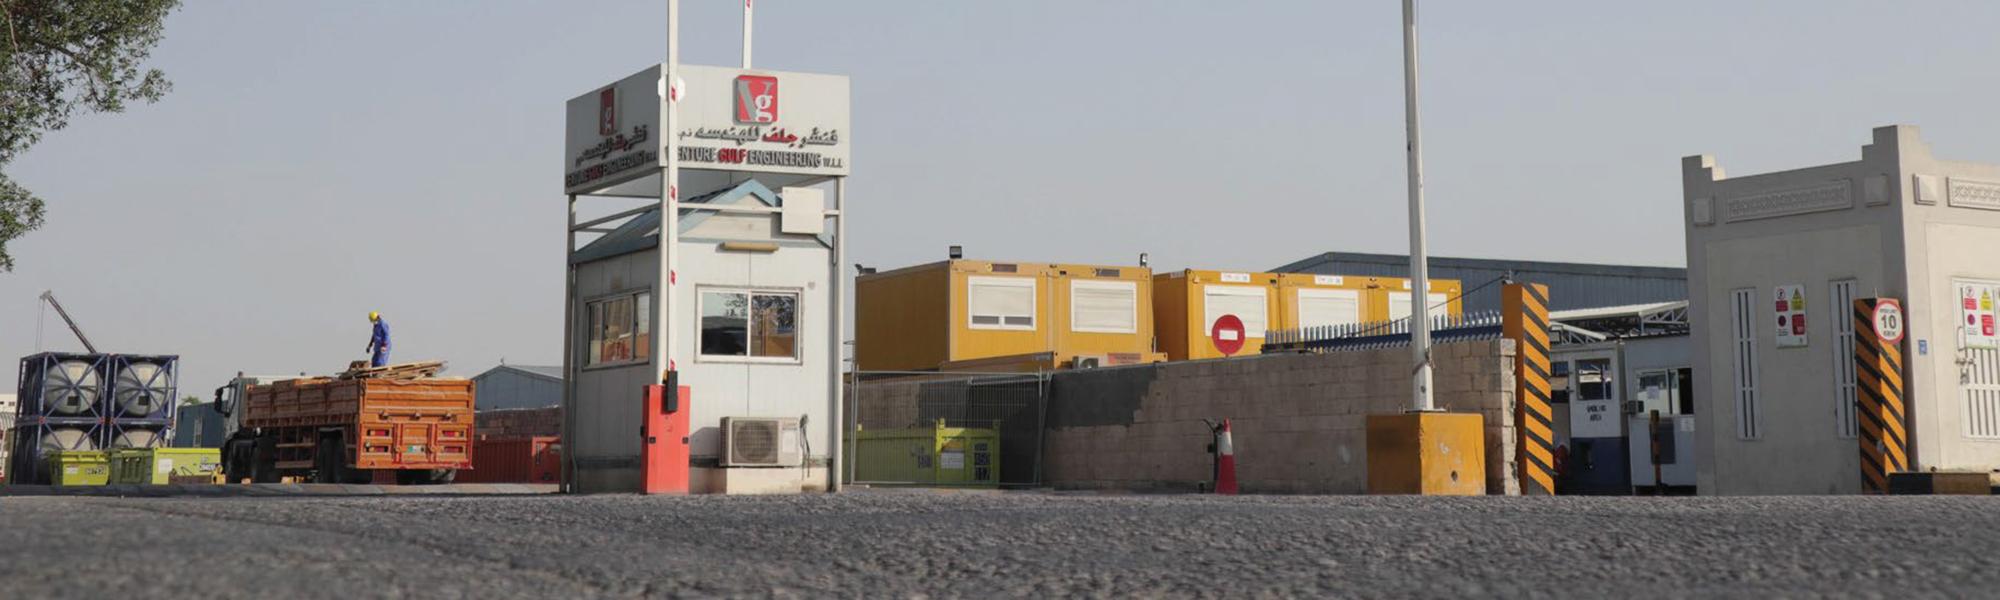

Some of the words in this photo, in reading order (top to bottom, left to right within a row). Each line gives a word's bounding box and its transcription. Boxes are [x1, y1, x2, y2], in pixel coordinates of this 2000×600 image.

[666, 146, 716, 162] ENTURE
[717, 147, 747, 164] GULF
[747, 150, 822, 168] ENGINEERING
[1881, 314, 1897, 330] 10
